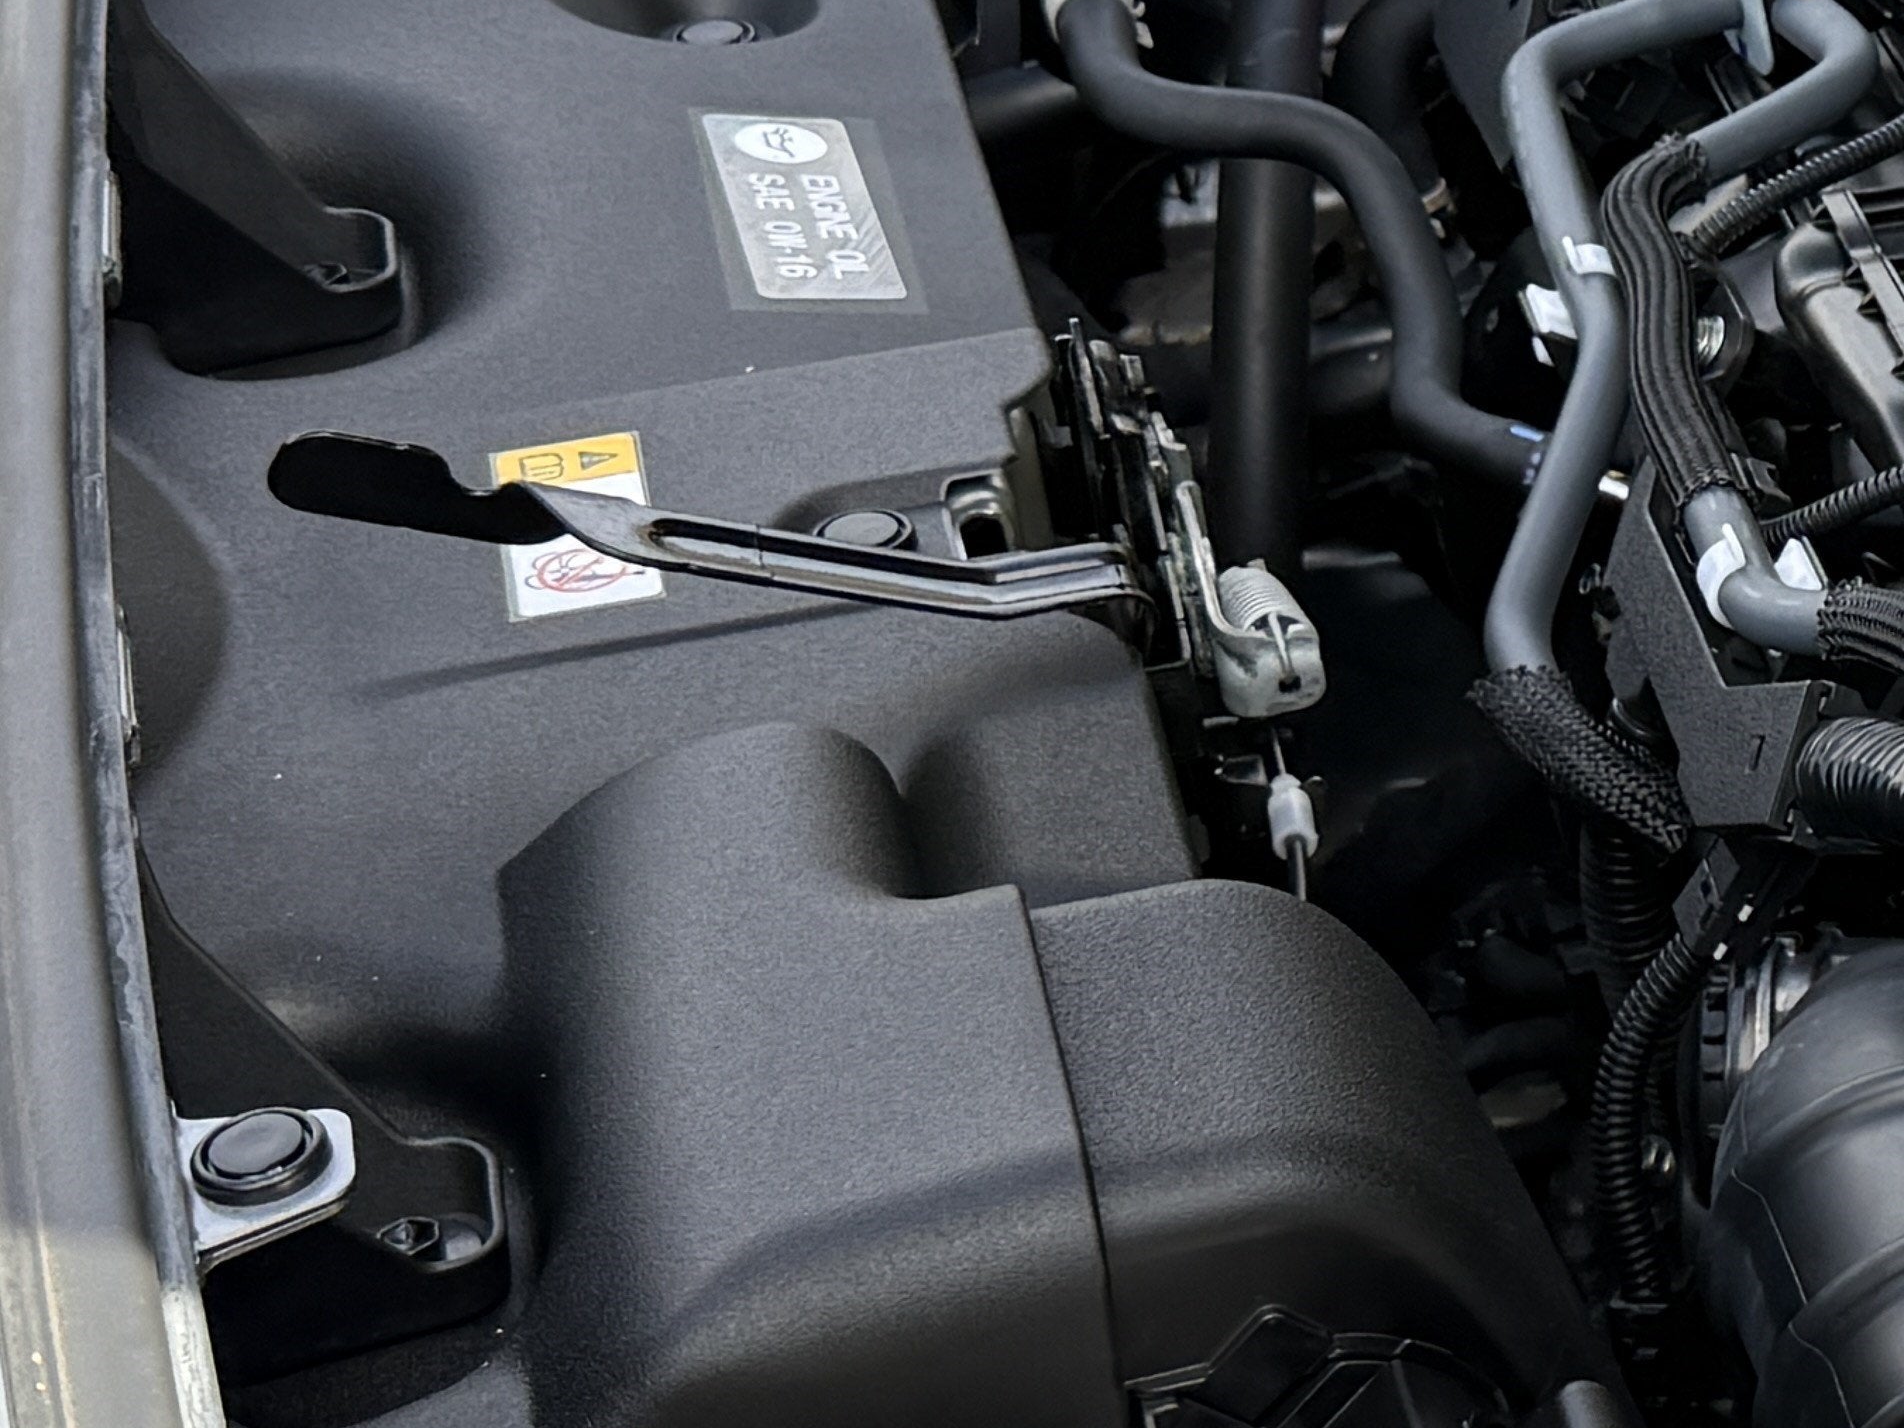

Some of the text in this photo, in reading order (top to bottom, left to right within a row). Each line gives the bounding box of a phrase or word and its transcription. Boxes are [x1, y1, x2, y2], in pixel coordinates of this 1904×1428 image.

[747, 173, 818, 279] SAE 0W-16
[800, 173, 869, 280] ENGINE OIL
